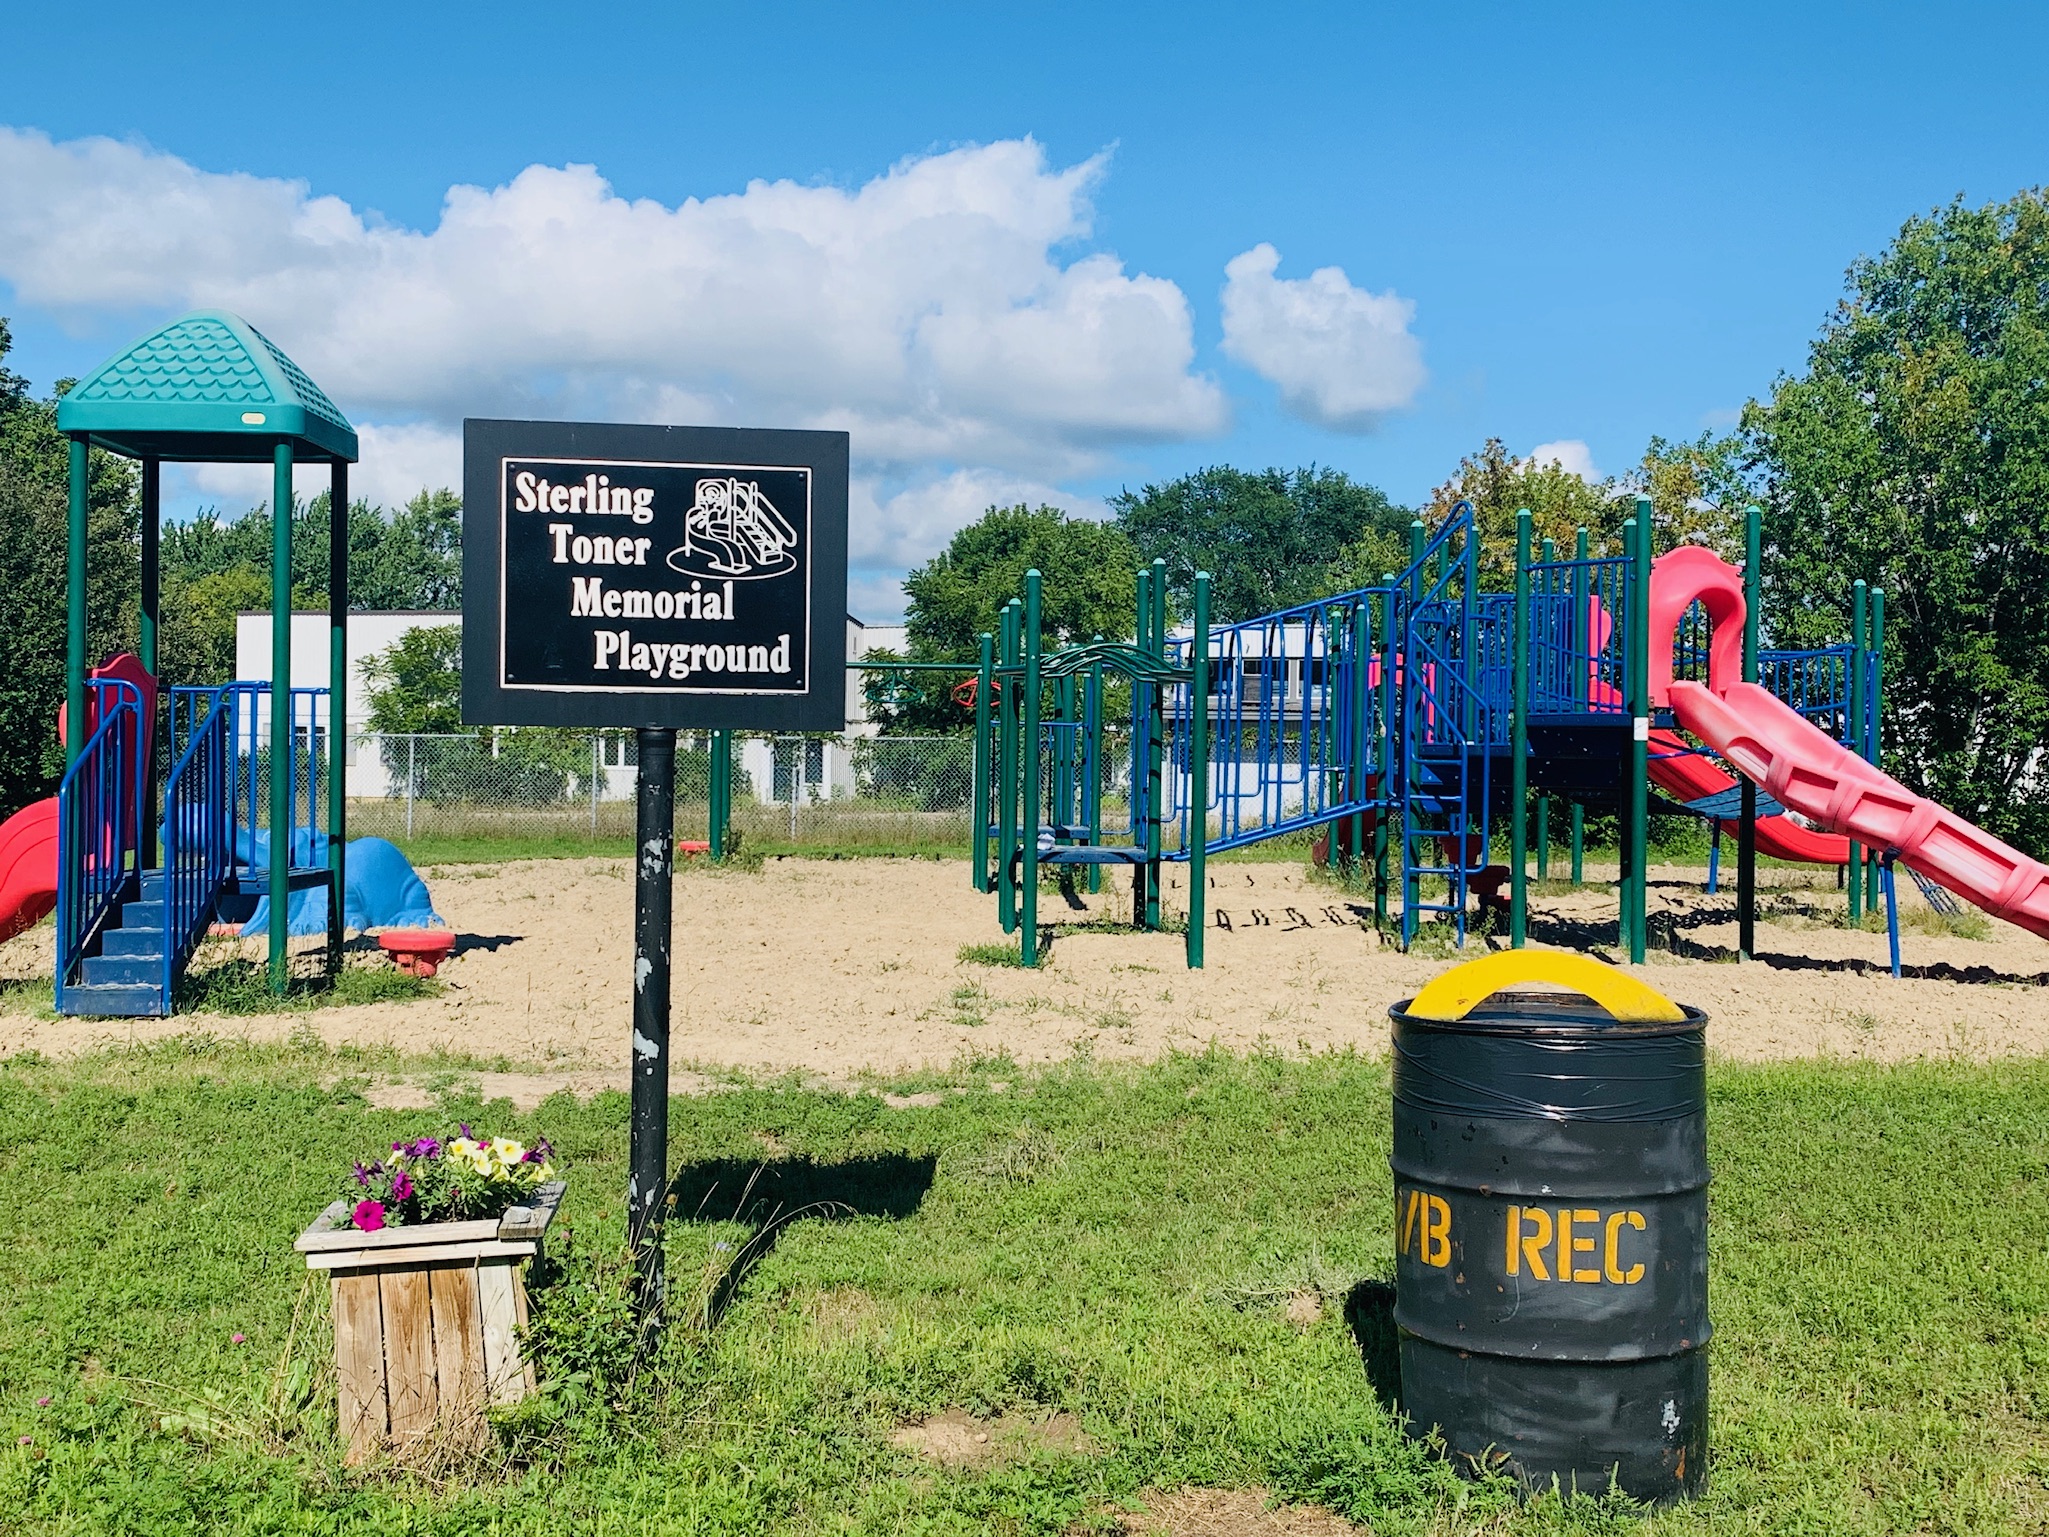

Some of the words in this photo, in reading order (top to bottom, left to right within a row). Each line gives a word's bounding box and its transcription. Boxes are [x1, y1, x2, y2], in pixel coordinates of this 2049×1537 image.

[515, 471, 655, 524] Sterling
[548, 523, 652, 566] Toner
[570, 576, 735, 621] Memorial
[593, 629, 792, 680] Playground
[1505, 1205, 1646, 1284] REC
